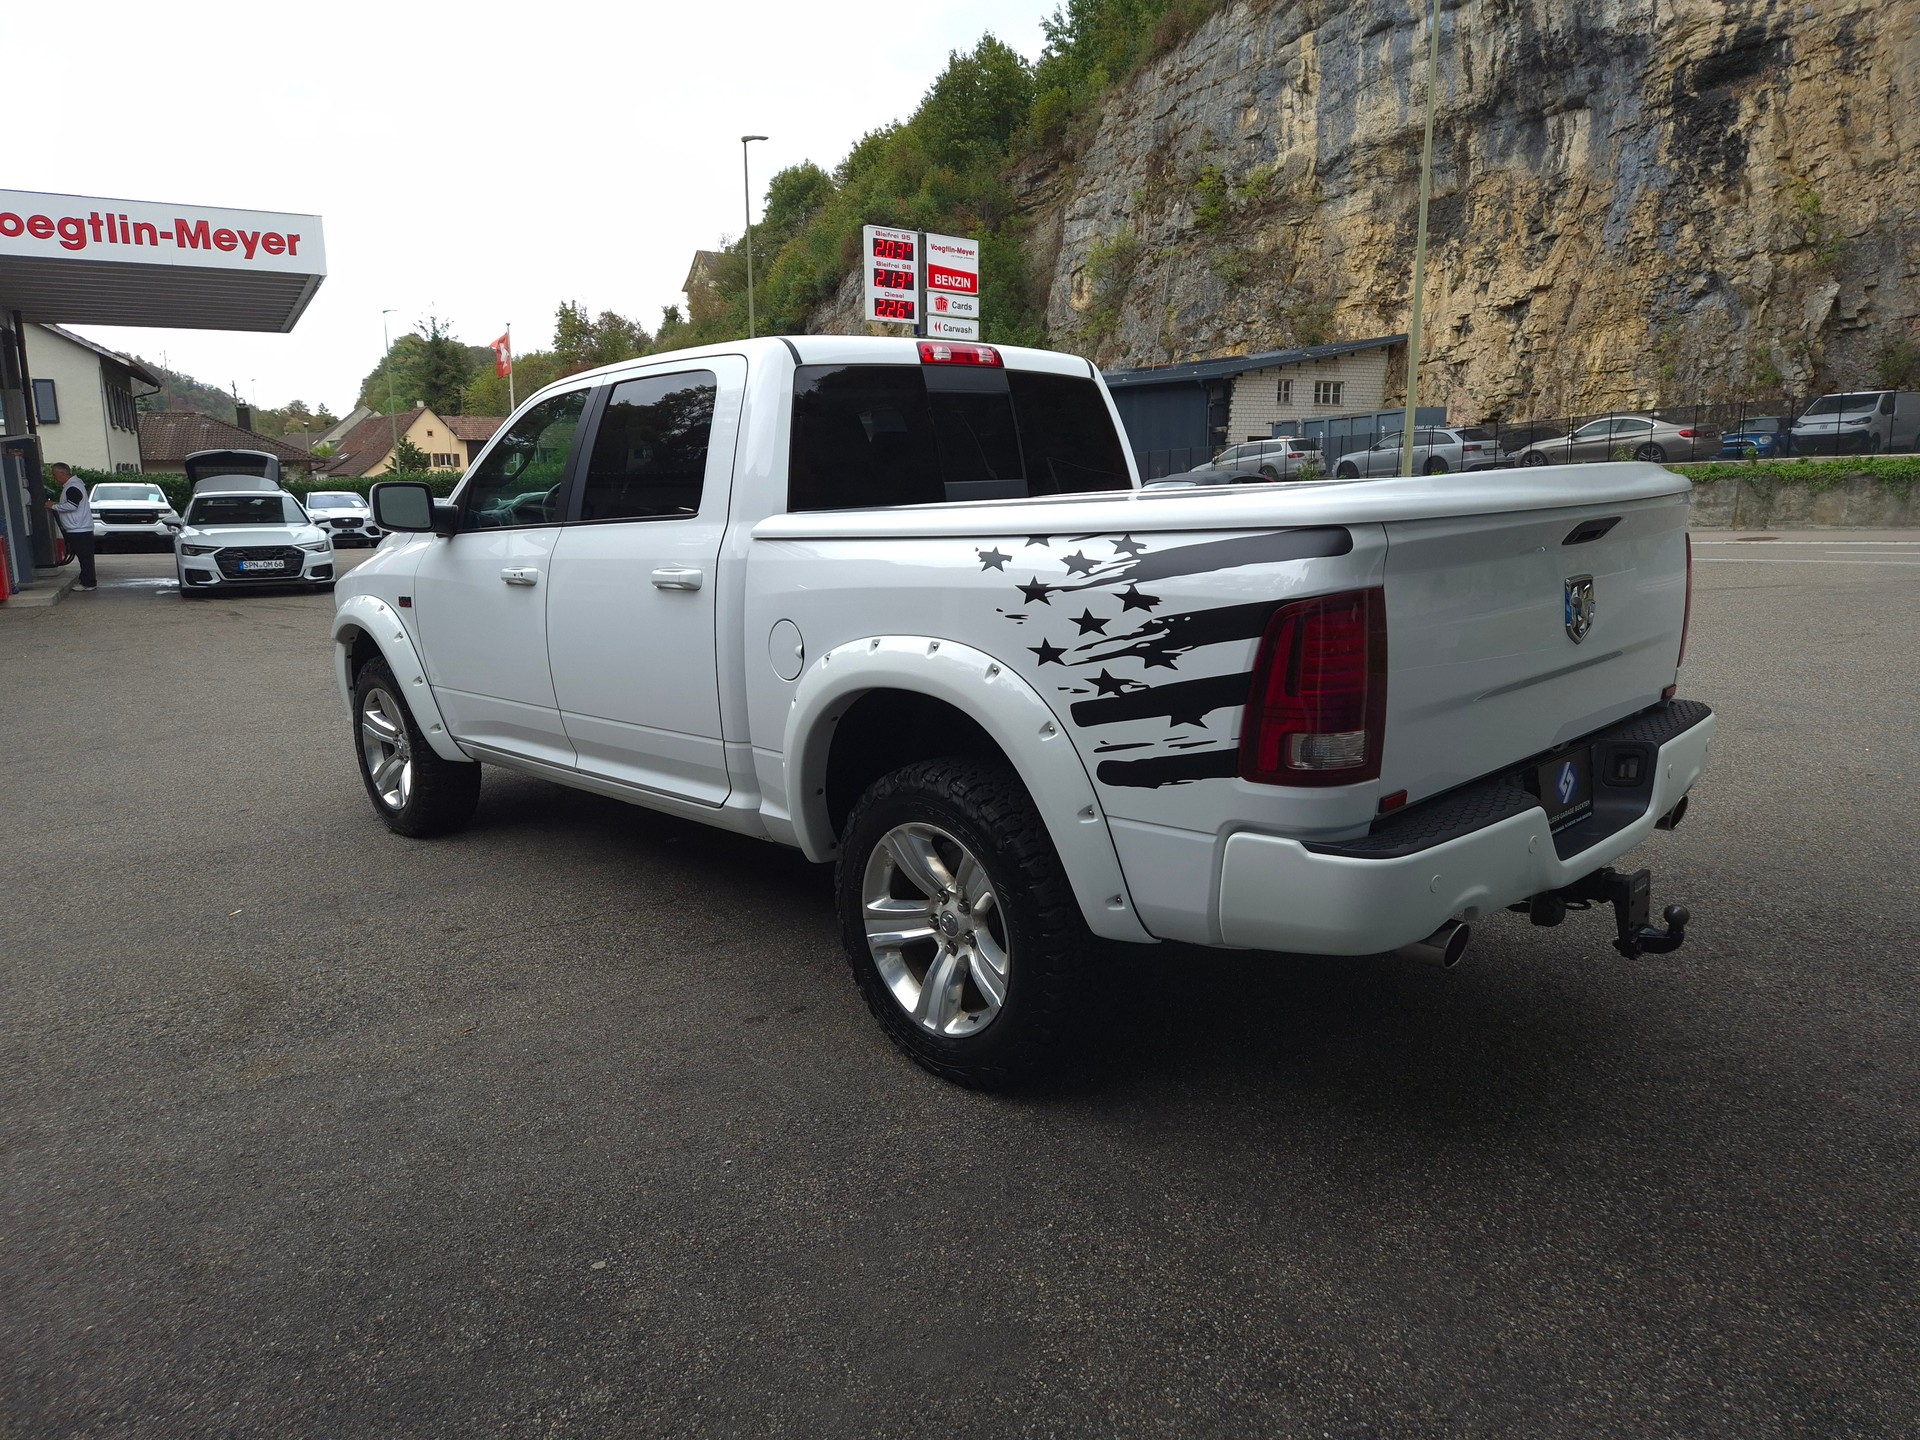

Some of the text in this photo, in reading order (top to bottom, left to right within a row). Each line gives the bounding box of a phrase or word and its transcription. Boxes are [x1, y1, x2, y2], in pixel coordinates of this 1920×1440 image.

[875, 230, 899, 239] Bleifrei
[930, 243, 975, 256] Voegtlin-Meyer
[876, 260, 900, 269] Bleifrei
[934, 274, 971, 289] BENZIN
[884, 291, 905, 299] Diesel
[951, 300, 973, 311] Cards
[943, 323, 973, 334] Carwash
[243, 561, 259, 569] SPN
